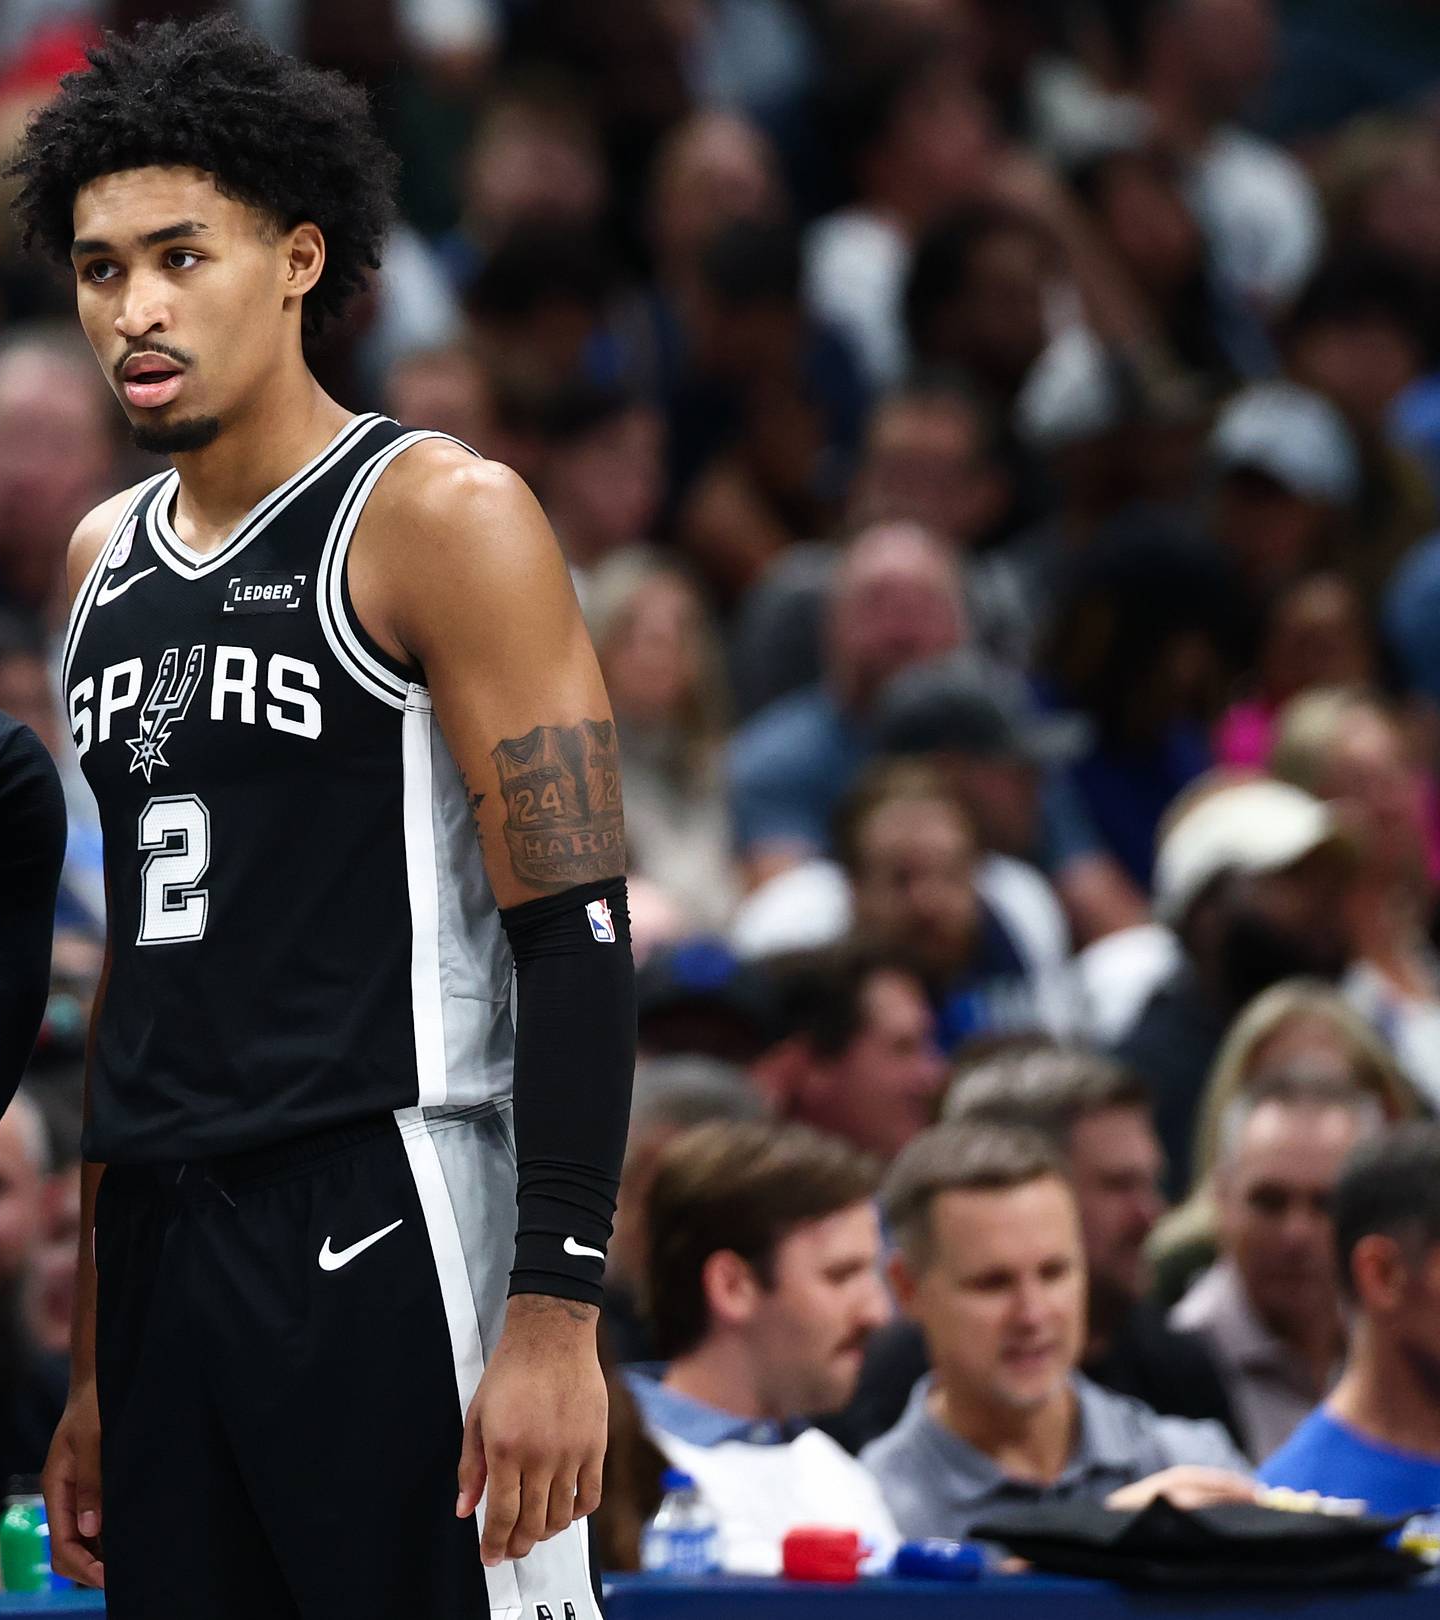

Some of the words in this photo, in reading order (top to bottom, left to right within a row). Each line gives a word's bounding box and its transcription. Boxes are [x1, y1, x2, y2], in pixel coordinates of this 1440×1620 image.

[233, 584, 293, 602] LEDGER
[69, 645, 322, 783] SPURS
[516, 782, 563, 823] 24
[136, 793, 210, 946] 2
